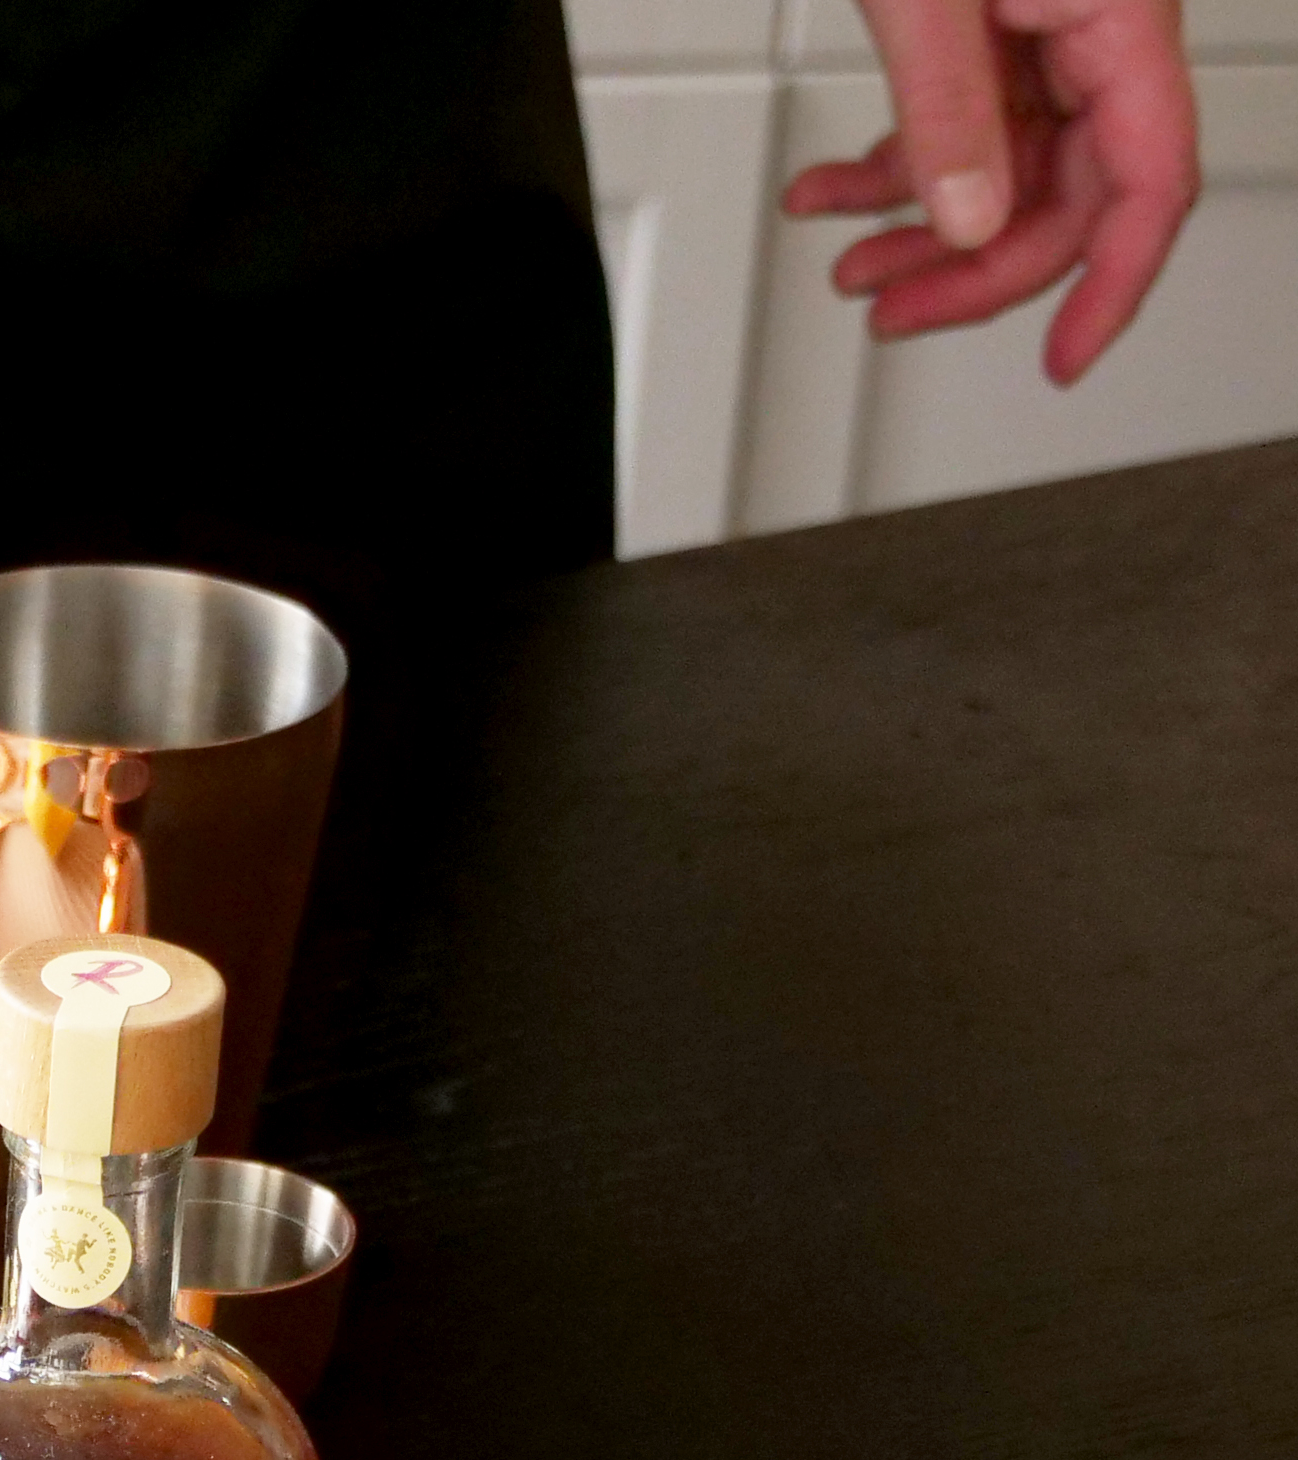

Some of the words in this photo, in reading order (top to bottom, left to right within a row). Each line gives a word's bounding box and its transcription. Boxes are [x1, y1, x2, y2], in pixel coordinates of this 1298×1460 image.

[61, 1205, 98, 1222] DANCE
[98, 1217, 116, 1243] LIKE
[33, 1265, 80, 1295] WATCHIN
